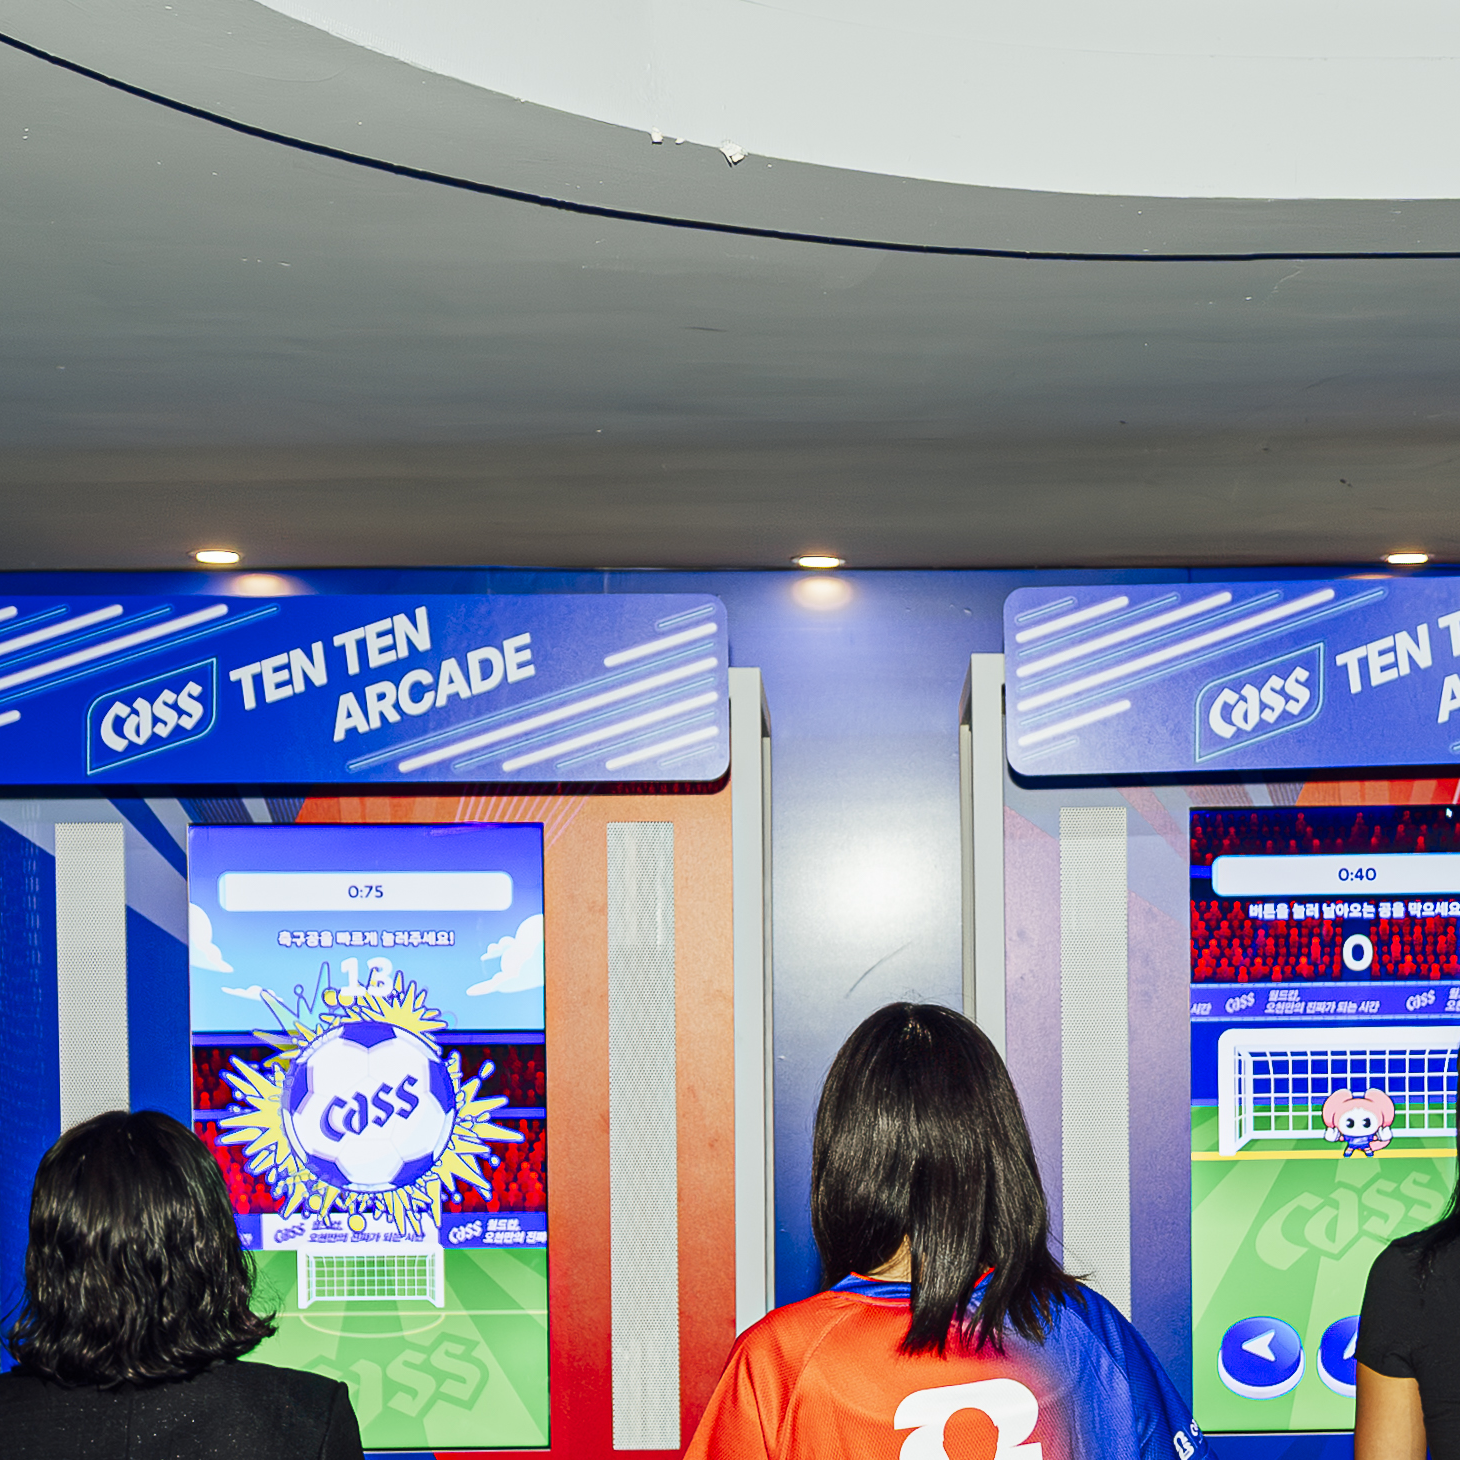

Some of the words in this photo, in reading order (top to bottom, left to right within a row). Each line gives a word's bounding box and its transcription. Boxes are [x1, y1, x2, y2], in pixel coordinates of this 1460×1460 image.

[229, 641, 328, 710] TEN
[333, 606, 432, 676] TEN
[1335, 623, 1433, 694] TEN
[333, 632, 535, 742] ARCADE
[347, 885, 384, 899] 0:75
[1338, 867, 1377, 881] 0:40
[1249, 903, 1289, 920] 버튼을
[1292, 903, 1320, 919] 눌러
[1322, 902, 1376, 919] 날아오는
[1378, 902, 1406, 918] 공을
[277, 931, 334, 947] 축구공을
[336, 931, 378, 947] 빠르게
[380, 930, 455, 947] 눌러주세요!
[1342, 934, 1374, 971] 0
[340, 957, 394, 997] 13
